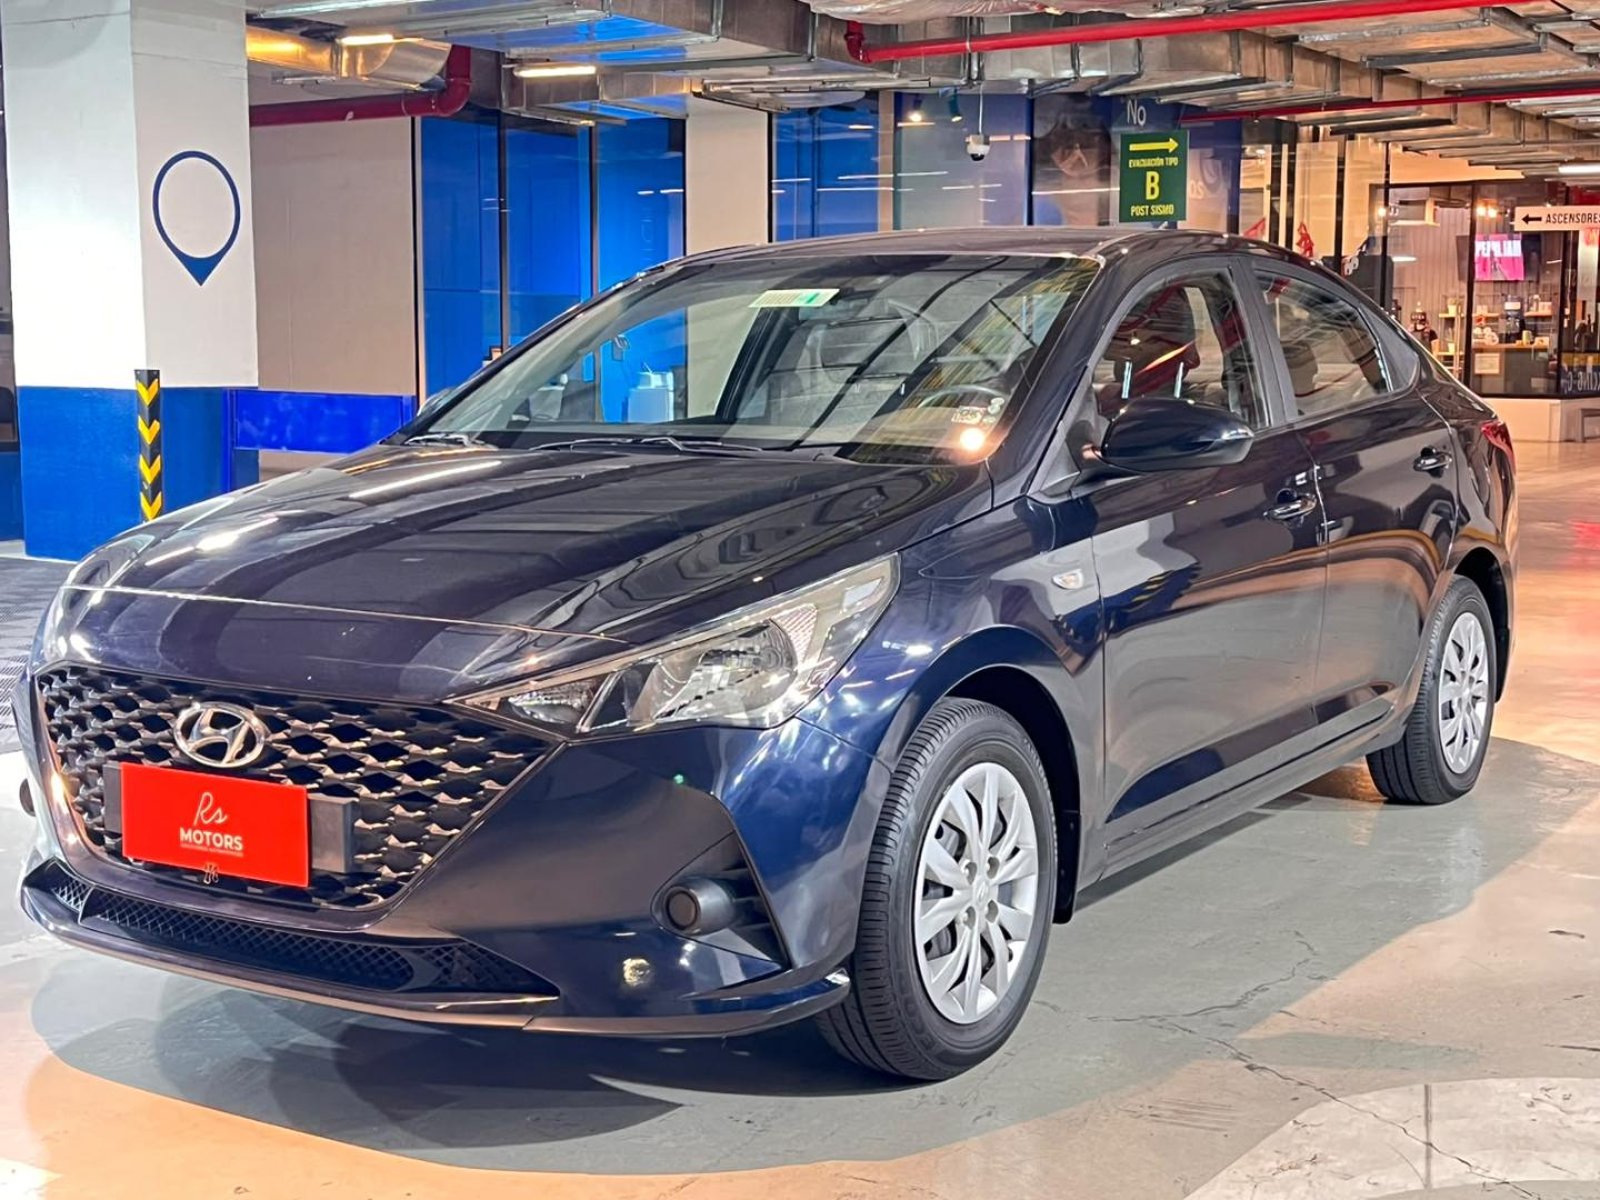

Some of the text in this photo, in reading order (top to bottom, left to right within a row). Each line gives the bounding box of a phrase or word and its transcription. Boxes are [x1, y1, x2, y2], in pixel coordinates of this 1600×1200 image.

[1165, 156, 1179, 167] TIPO
[1145, 171, 1160, 200] B
[1130, 204, 1174, 216] POST SISMO
[179, 826, 243, 852] MOTORS
